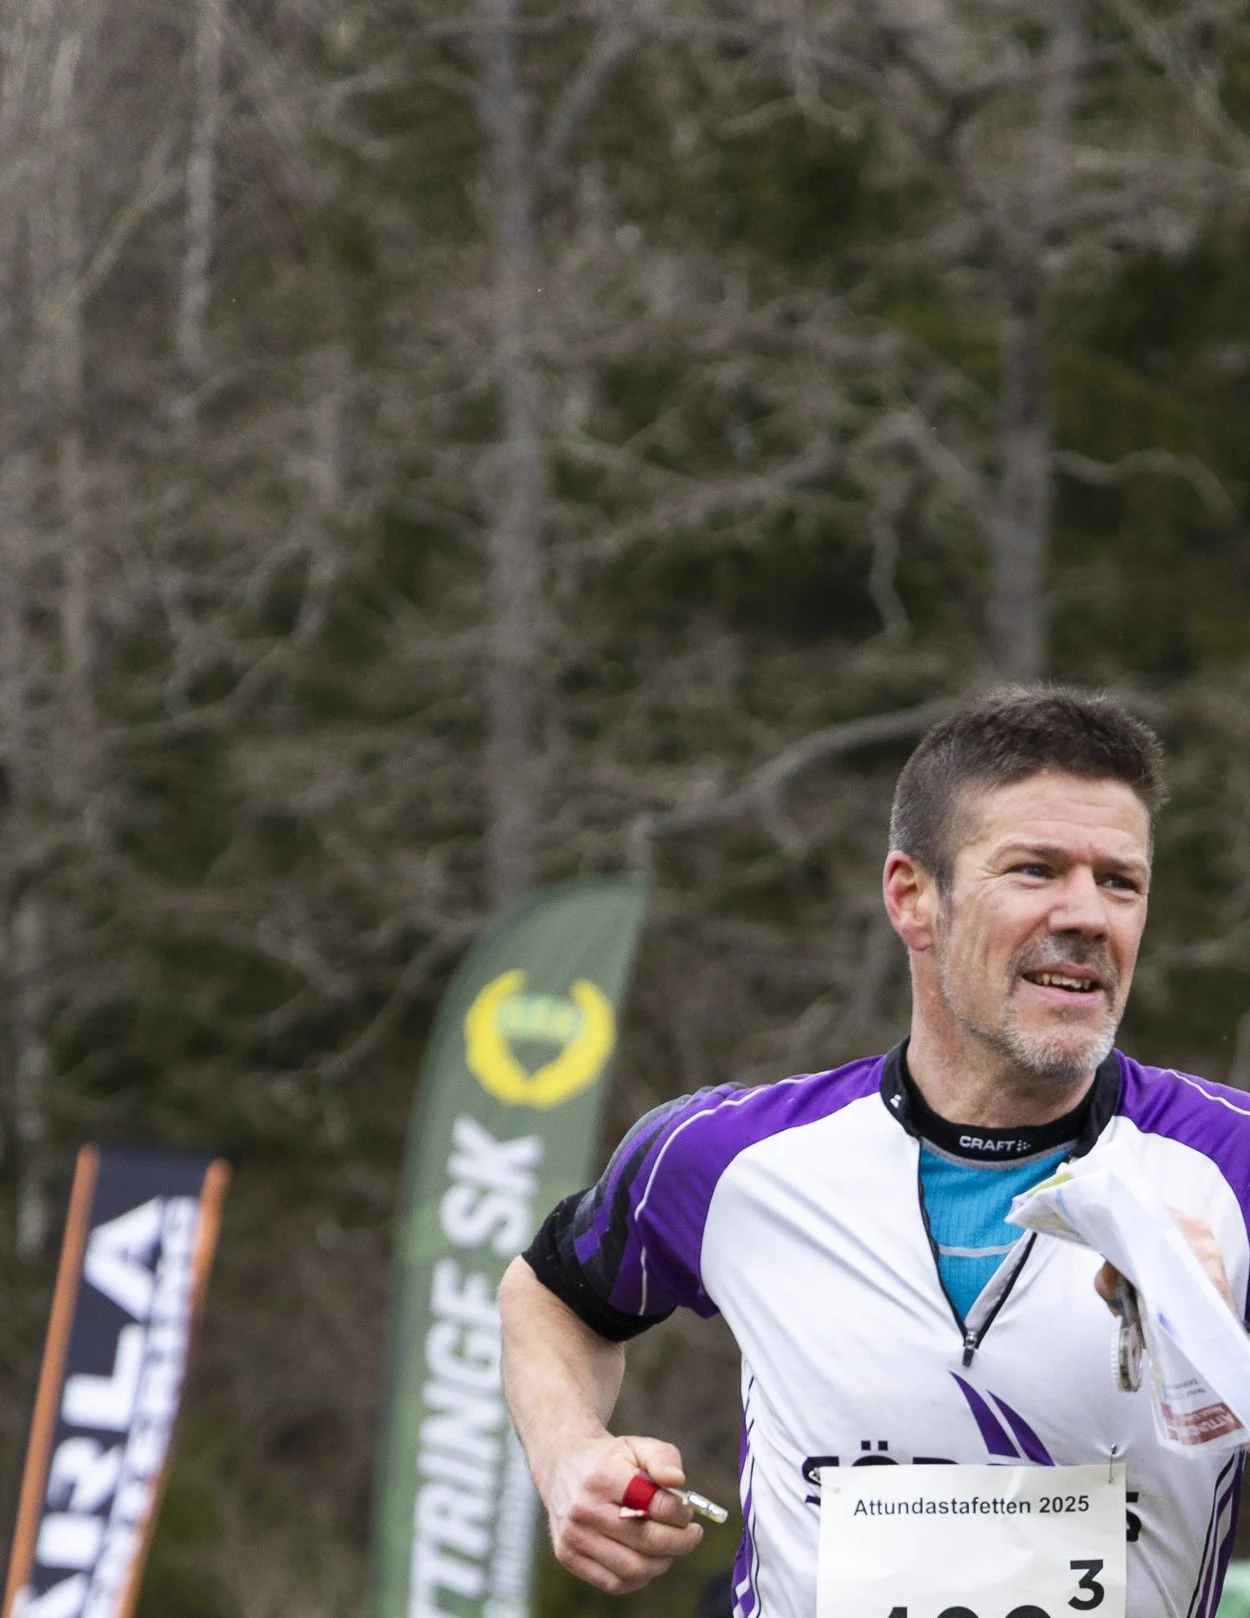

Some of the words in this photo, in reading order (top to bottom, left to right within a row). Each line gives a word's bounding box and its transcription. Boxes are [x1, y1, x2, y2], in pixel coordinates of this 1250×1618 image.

[959, 1135, 1016, 1152] CRAFT
[440, 1113, 544, 1259] SK
[853, 1496, 1031, 1516] Attundastafetten
[1038, 1494, 1090, 1514] 2025
[1067, 1558, 1105, 1611] 3
